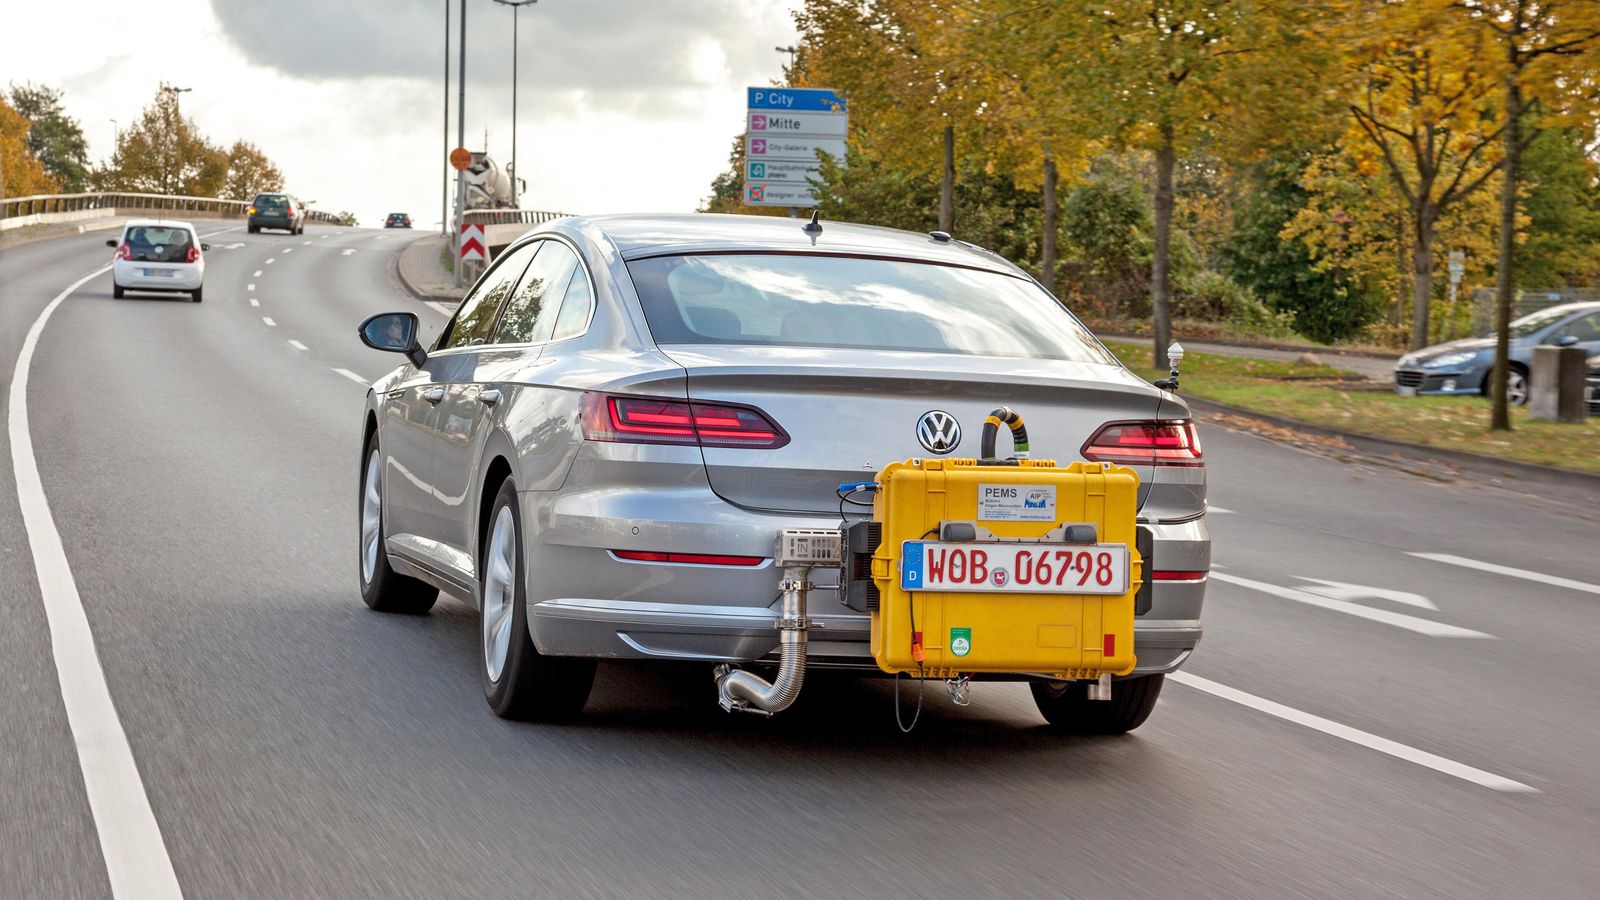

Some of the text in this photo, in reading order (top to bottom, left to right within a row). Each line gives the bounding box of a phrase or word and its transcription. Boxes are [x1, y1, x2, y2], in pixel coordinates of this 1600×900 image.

[755, 92, 794, 107] P City
[769, 117, 801, 129] Mitte
[769, 144, 808, 152] City-Galerie
[985, 488, 1017, 498] PEMS
[927, 548, 1113, 587] WOB 06798
[909, 570, 917, 581] D
